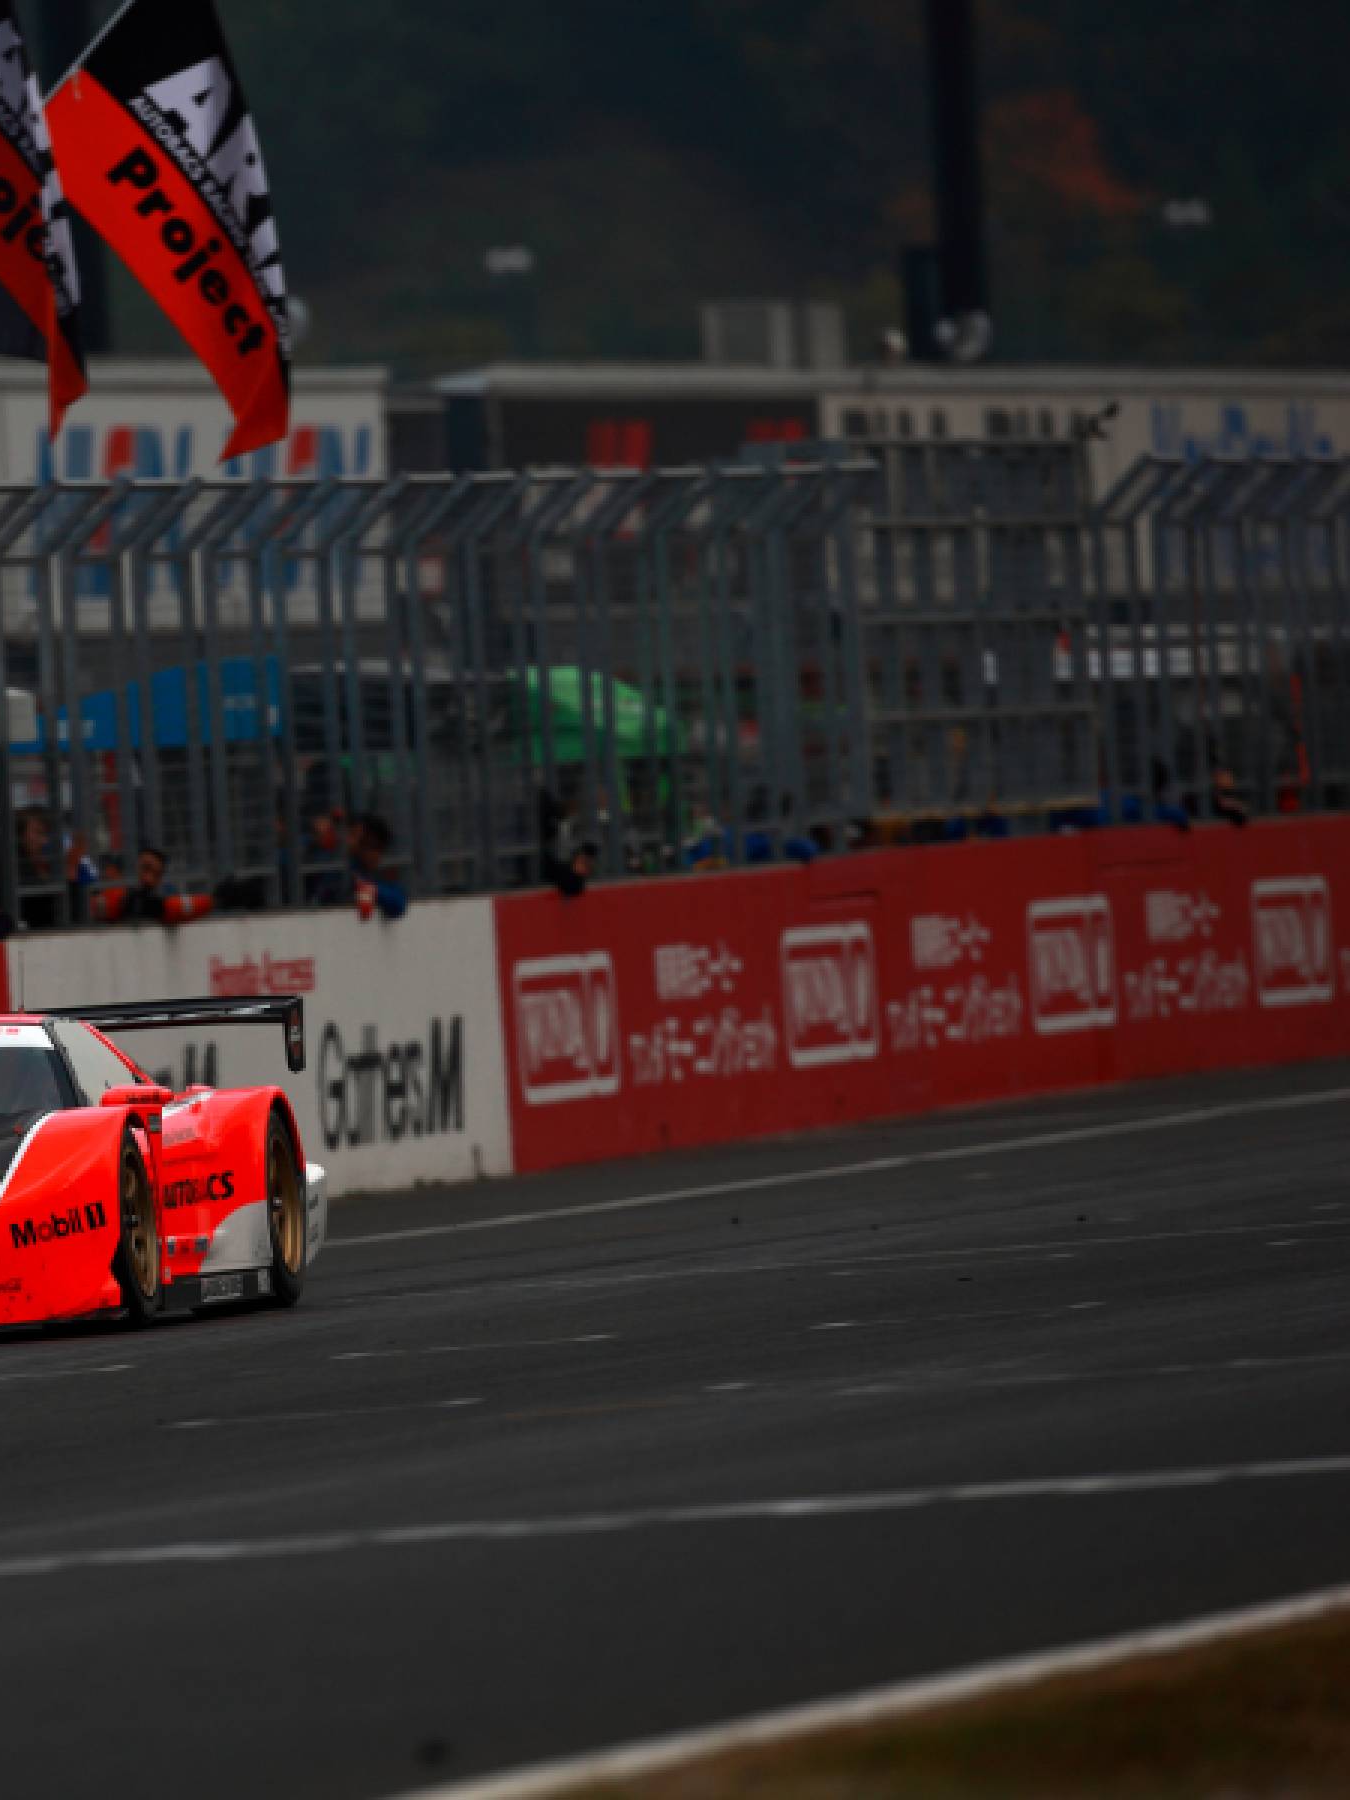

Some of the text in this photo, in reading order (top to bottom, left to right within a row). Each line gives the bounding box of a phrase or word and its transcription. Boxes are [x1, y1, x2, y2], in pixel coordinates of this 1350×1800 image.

[107, 148, 267, 356] Project
[10, 1202, 107, 1249] Mobil 1
